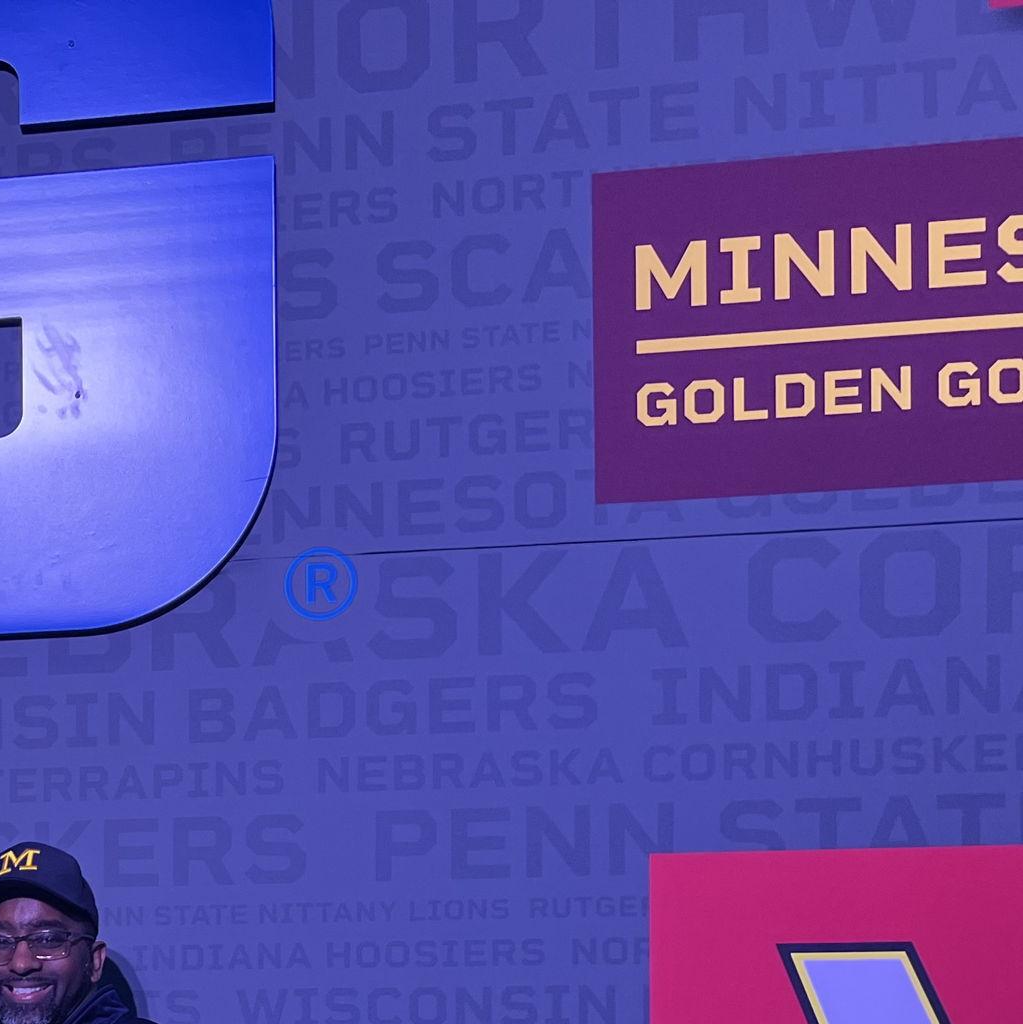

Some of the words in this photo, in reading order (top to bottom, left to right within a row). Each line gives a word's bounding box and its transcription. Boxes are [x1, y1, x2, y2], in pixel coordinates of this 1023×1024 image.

[427, 82, 700, 162] STATE
[733, 54, 1016, 135] NITTA
[364, 328, 451, 355] PENN
[460, 319, 561, 349] STATE
[323, 362, 543, 406] HOOSIERS
[636, 364, 912, 427] GOLDEN
[189, 671, 599, 743] BADGERS
[651, 654, 1023, 726] INDIAN
[318, 747, 624, 794] NEBRASKA
[378, 801, 675, 880] PENN
[155, 904, 248, 926] STATE
[259, 900, 397, 925] NITTANY
[408, 898, 511, 921] LIONS
[132, 943, 313, 973] INDIANA
[326, 938, 546, 969] HOOSIERS
